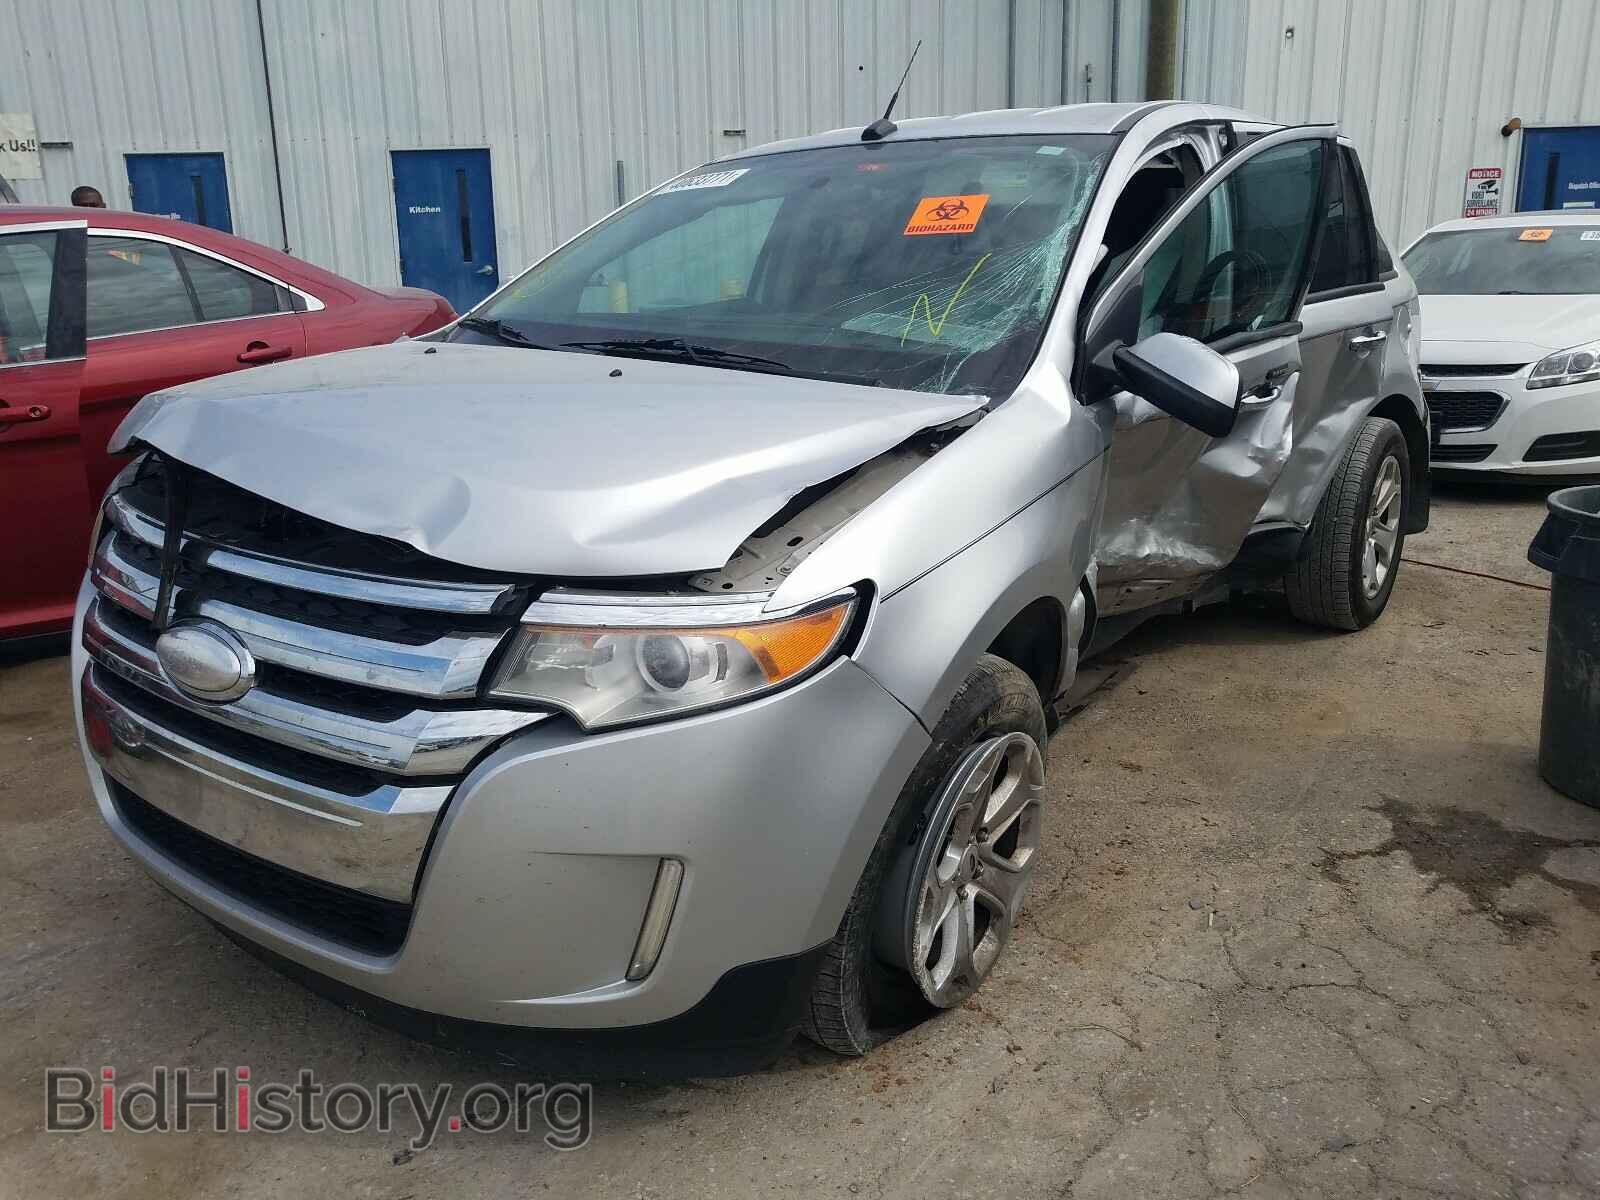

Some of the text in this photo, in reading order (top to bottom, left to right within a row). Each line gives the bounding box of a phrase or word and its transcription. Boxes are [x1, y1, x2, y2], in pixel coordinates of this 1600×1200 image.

[9, 139, 36, 152] Us!!
[1471, 170, 1501, 178] NOTICE
[1472, 191, 1485, 199] VIDEO
[1466, 199, 1498, 207] SURVEILLANCE
[409, 206, 441, 214] Kitchen
[906, 223, 975, 233] BIOHAZARD
